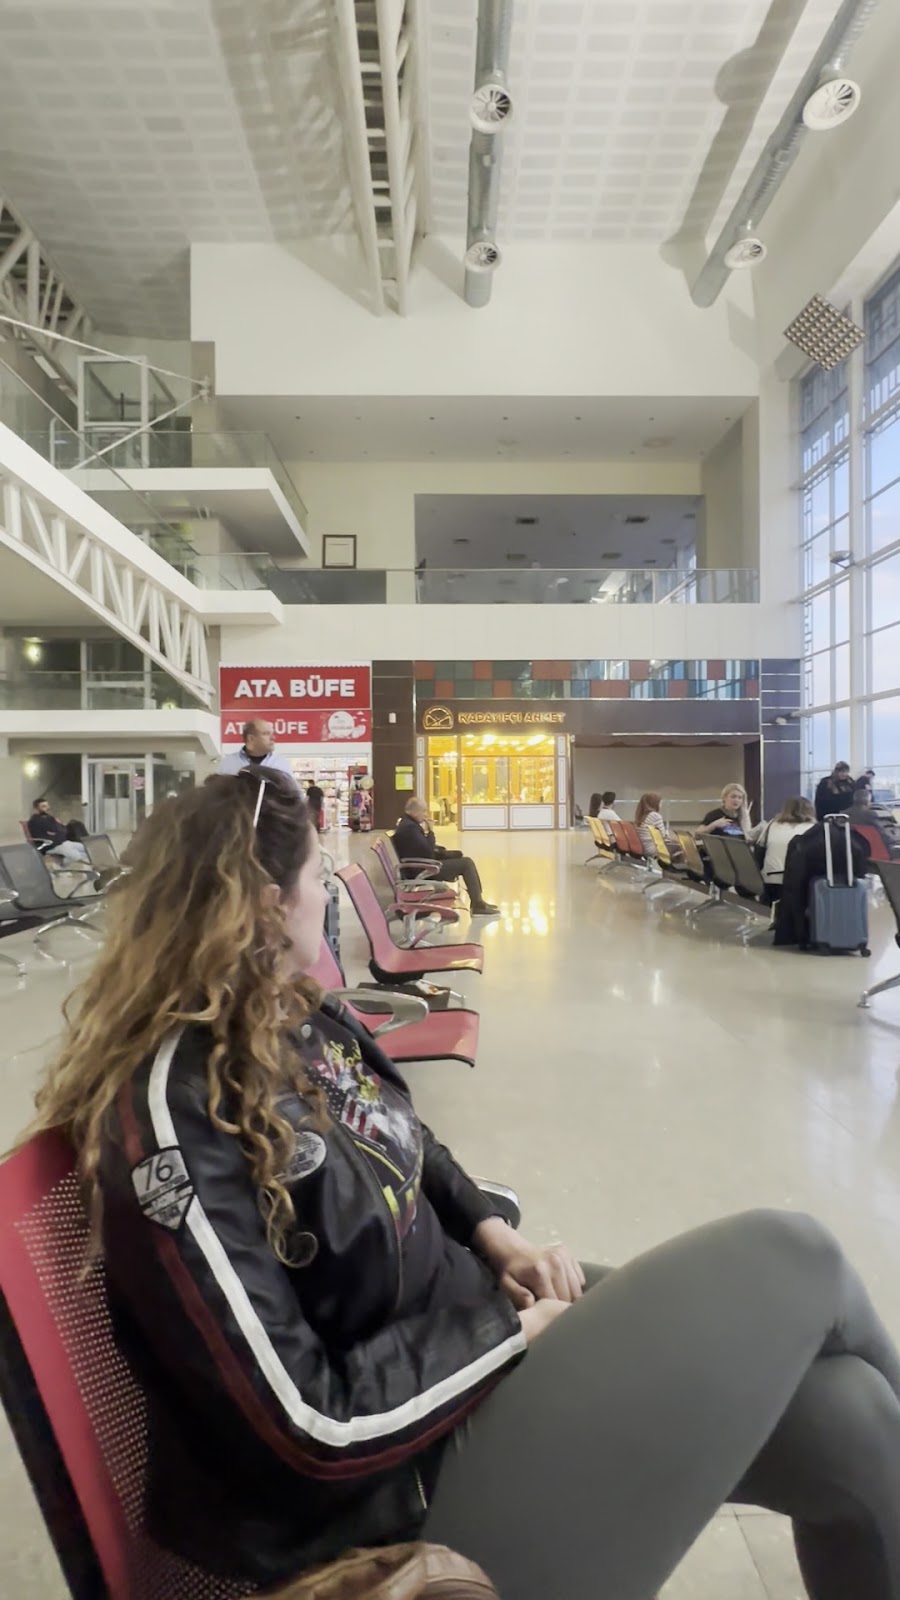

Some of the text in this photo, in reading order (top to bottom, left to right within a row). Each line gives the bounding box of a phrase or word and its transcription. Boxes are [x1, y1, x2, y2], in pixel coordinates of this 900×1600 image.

[234, 675, 356, 698] ATA BÜFE
[524, 711, 566, 723] AHMET
[224, 721, 244, 735] AT
[139, 1154, 174, 1191] 76
